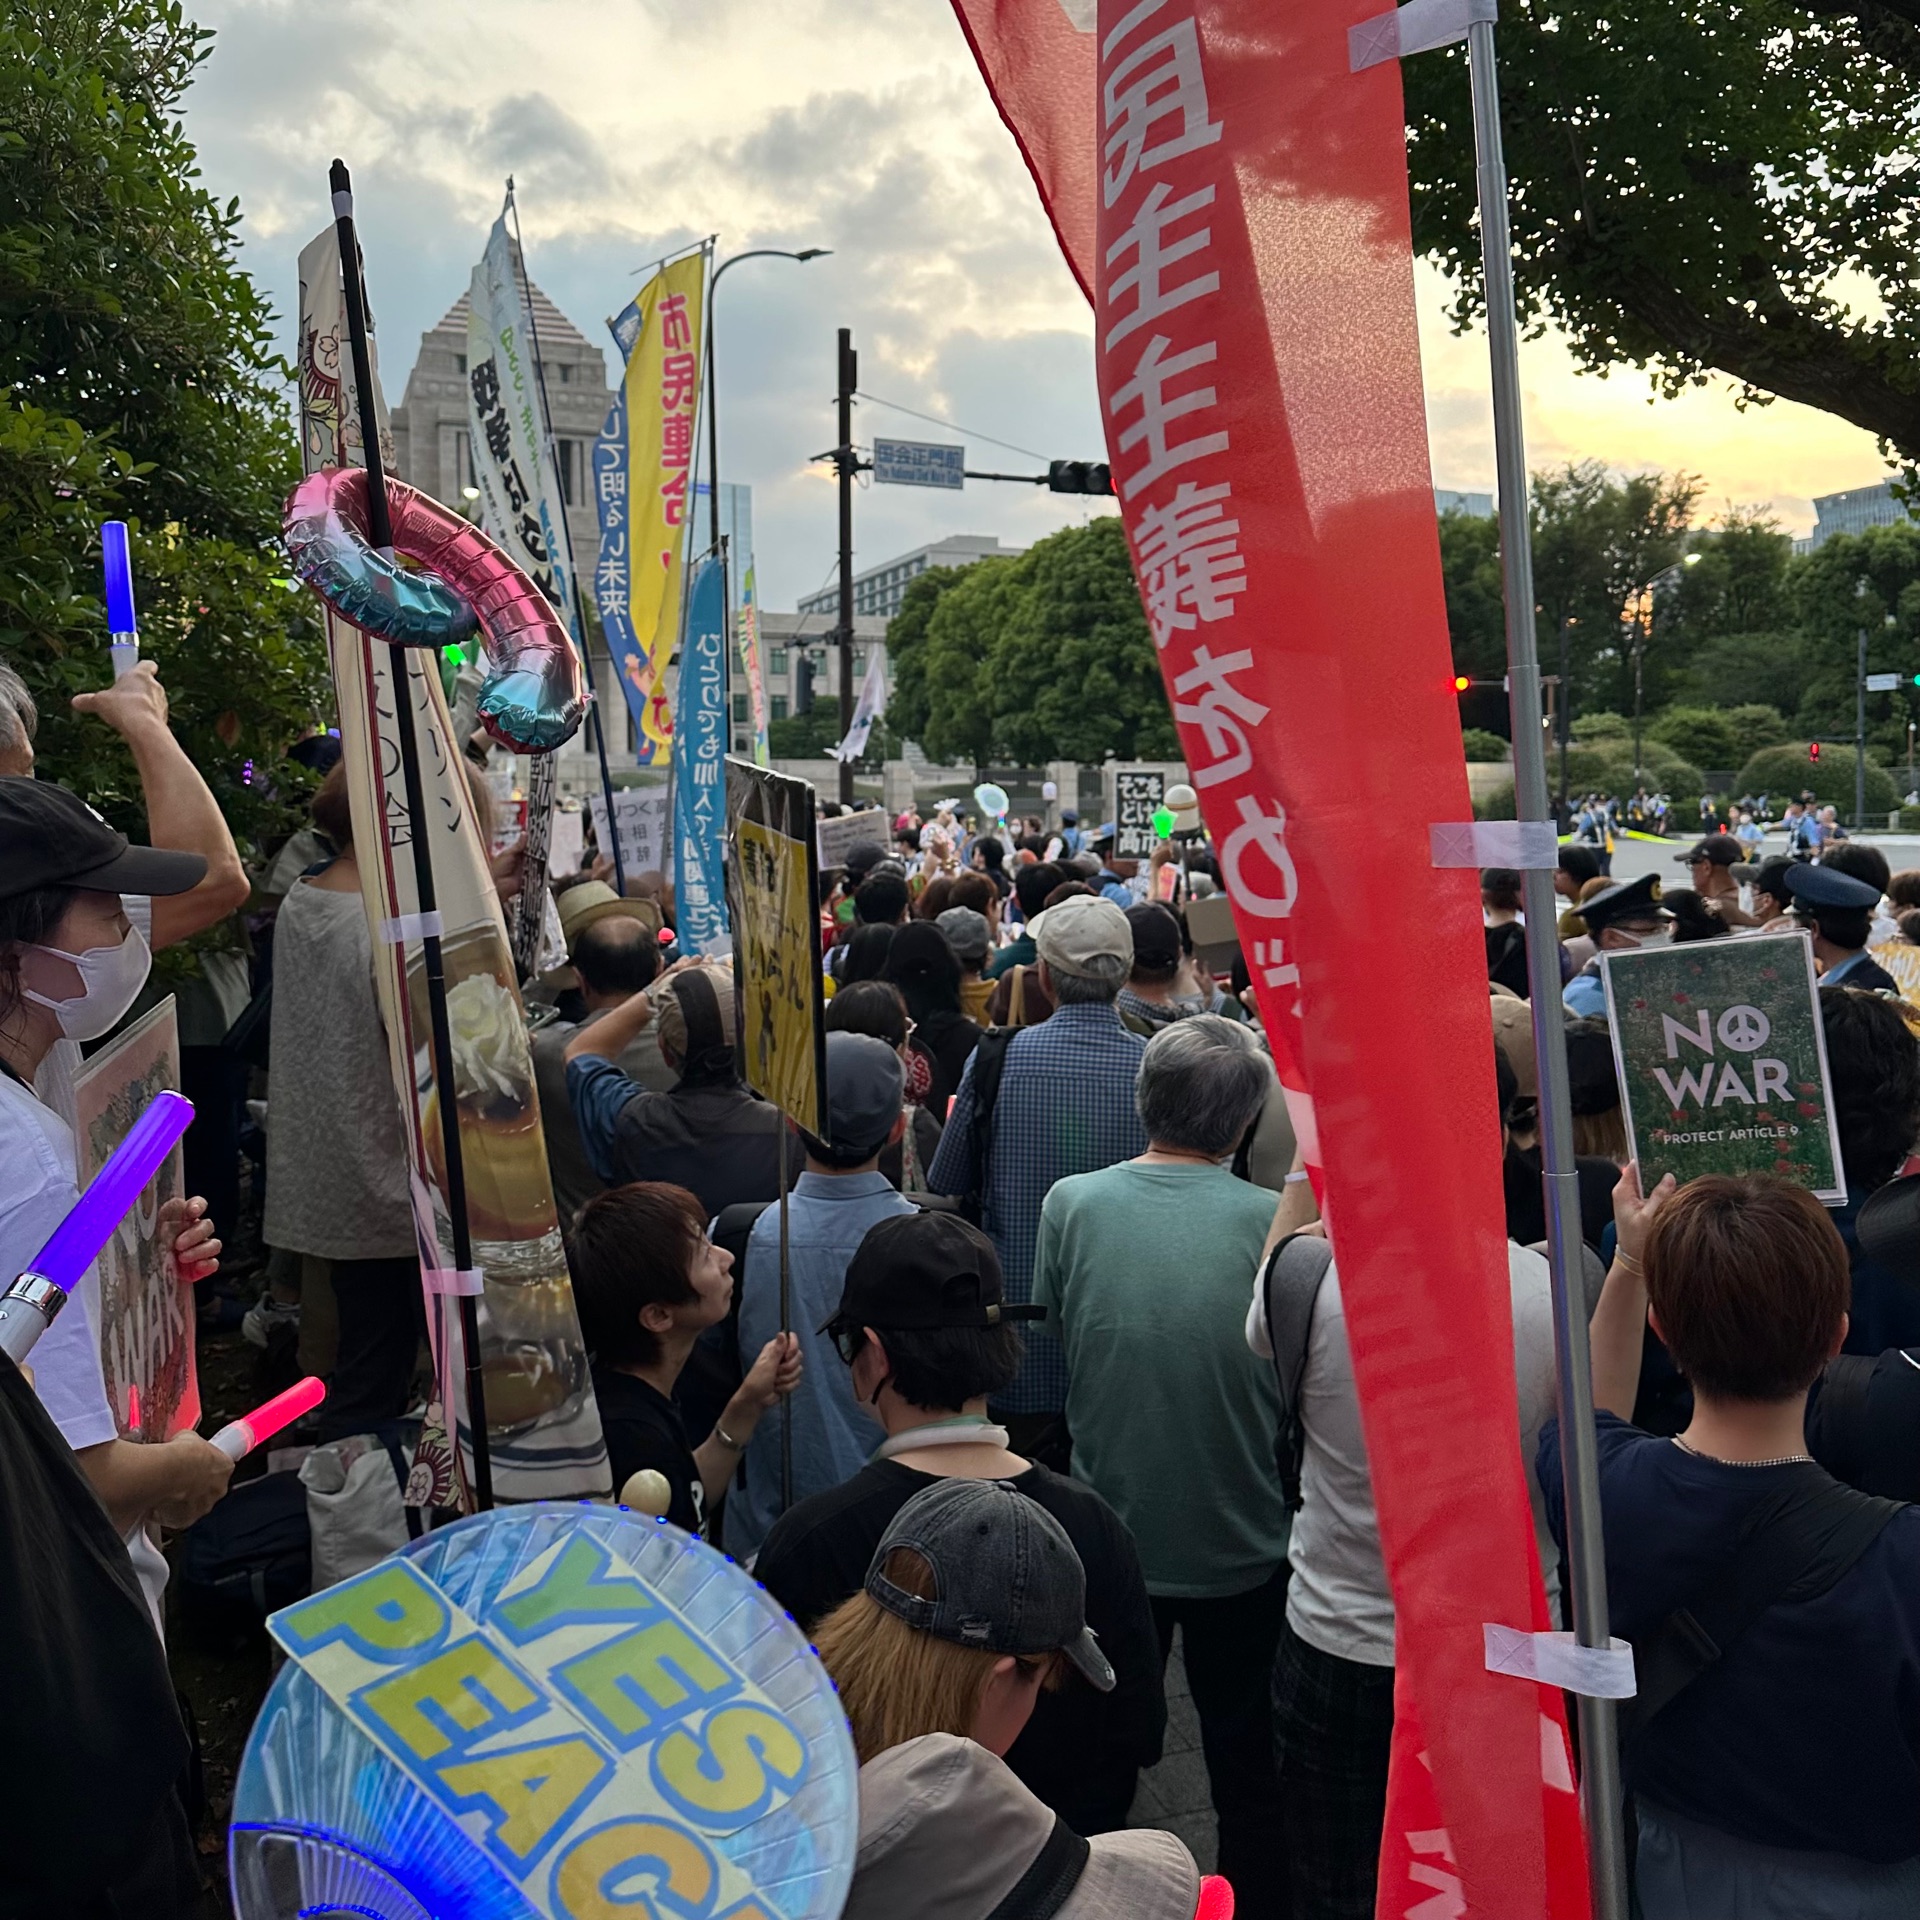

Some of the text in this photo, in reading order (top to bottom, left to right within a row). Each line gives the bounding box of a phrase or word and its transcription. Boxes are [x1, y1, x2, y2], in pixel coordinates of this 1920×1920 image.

[877, 443, 961, 470] 国会正門前
[1118, 775, 1162, 800] そこを
[1661, 1004, 1771, 1059] NO
[1652, 1058, 1796, 1110] WAR
[1663, 1124, 1800, 1145] PROTECT ARTICLE 9
[109, 1250, 185, 1424] WAR
[487, 1529, 811, 1831] YES
[274, 1557, 784, 1920] PEAC
